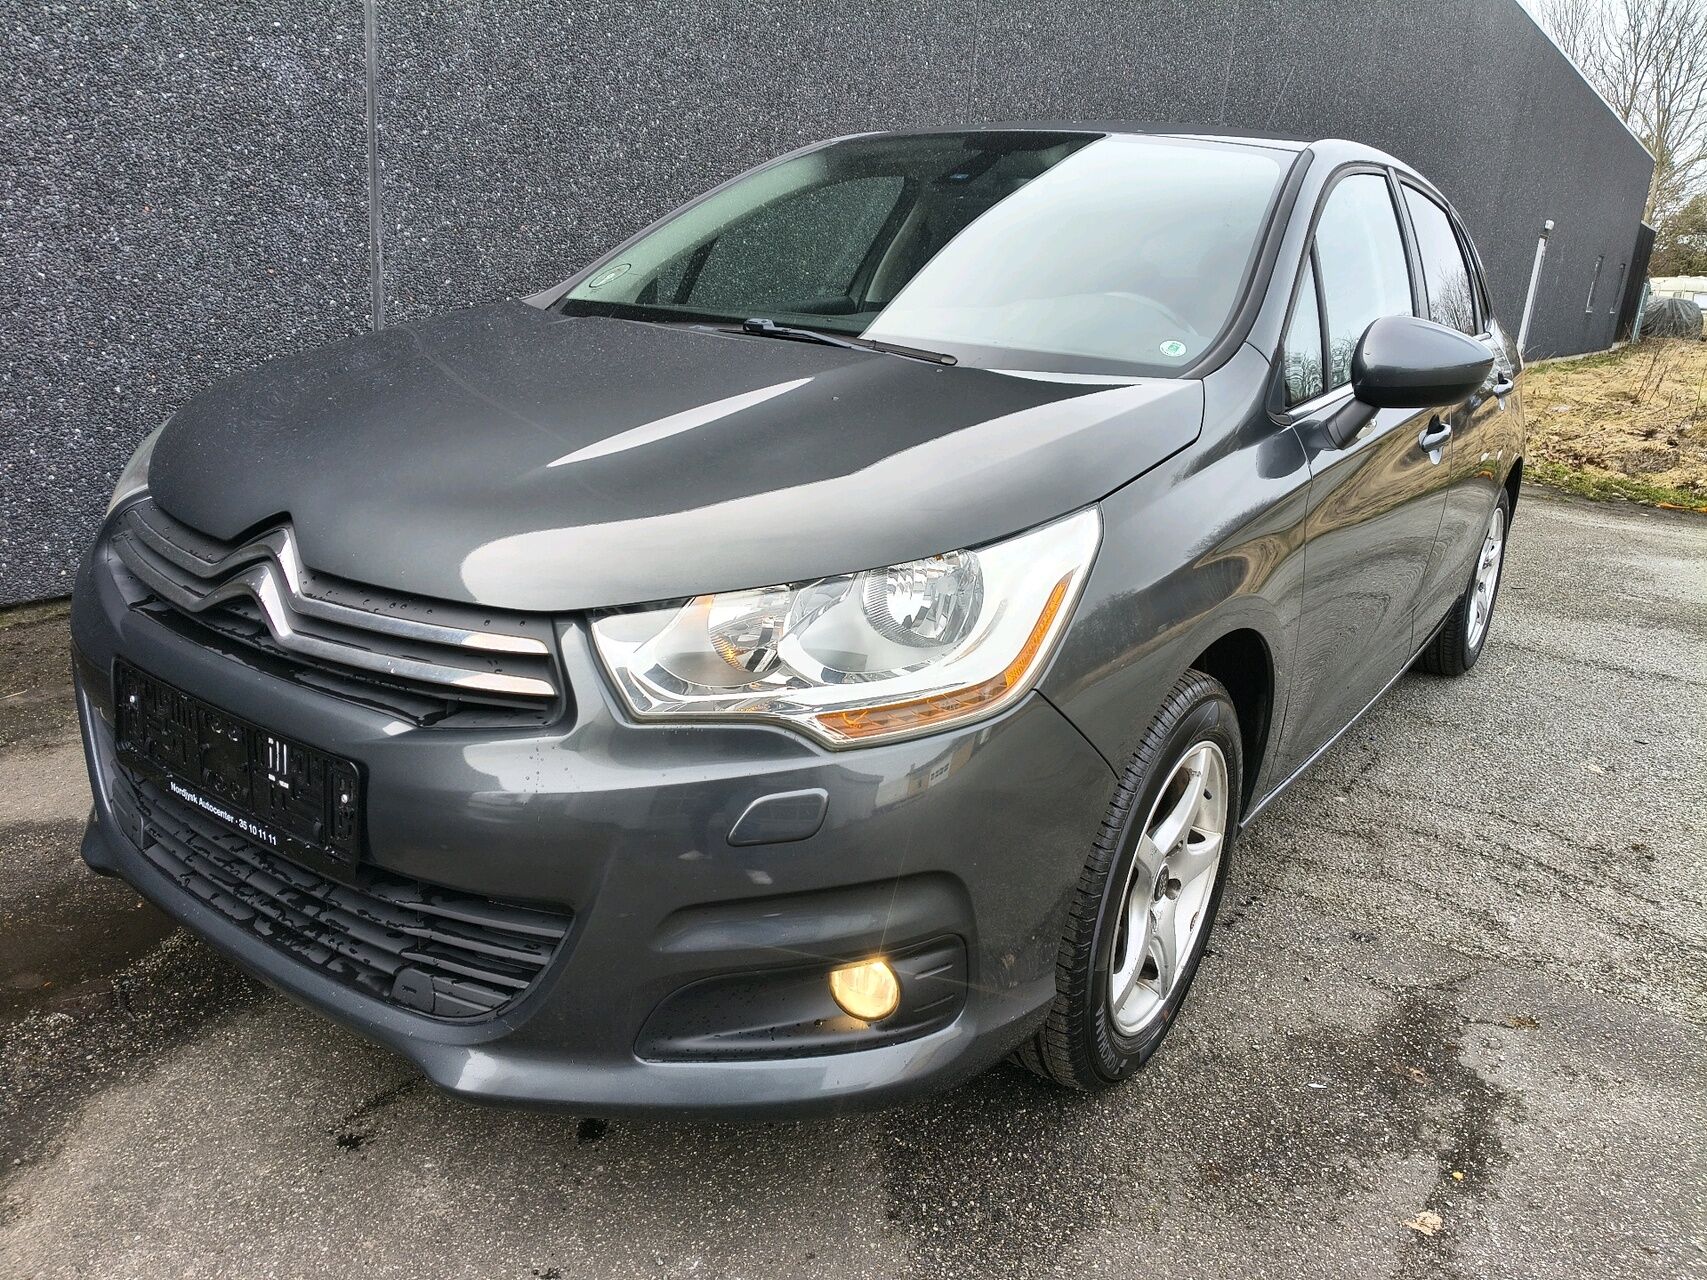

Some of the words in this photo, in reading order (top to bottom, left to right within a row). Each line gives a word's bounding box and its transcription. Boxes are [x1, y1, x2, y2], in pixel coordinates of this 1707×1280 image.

[170, 781, 198, 804] Nordjysk
[199, 798, 234, 823] Autocenter
[238, 818, 248, 831] 35
[249, 824, 257, 836] 10
[259, 829, 267, 841] 11
[268, 834, 277, 846] 11
